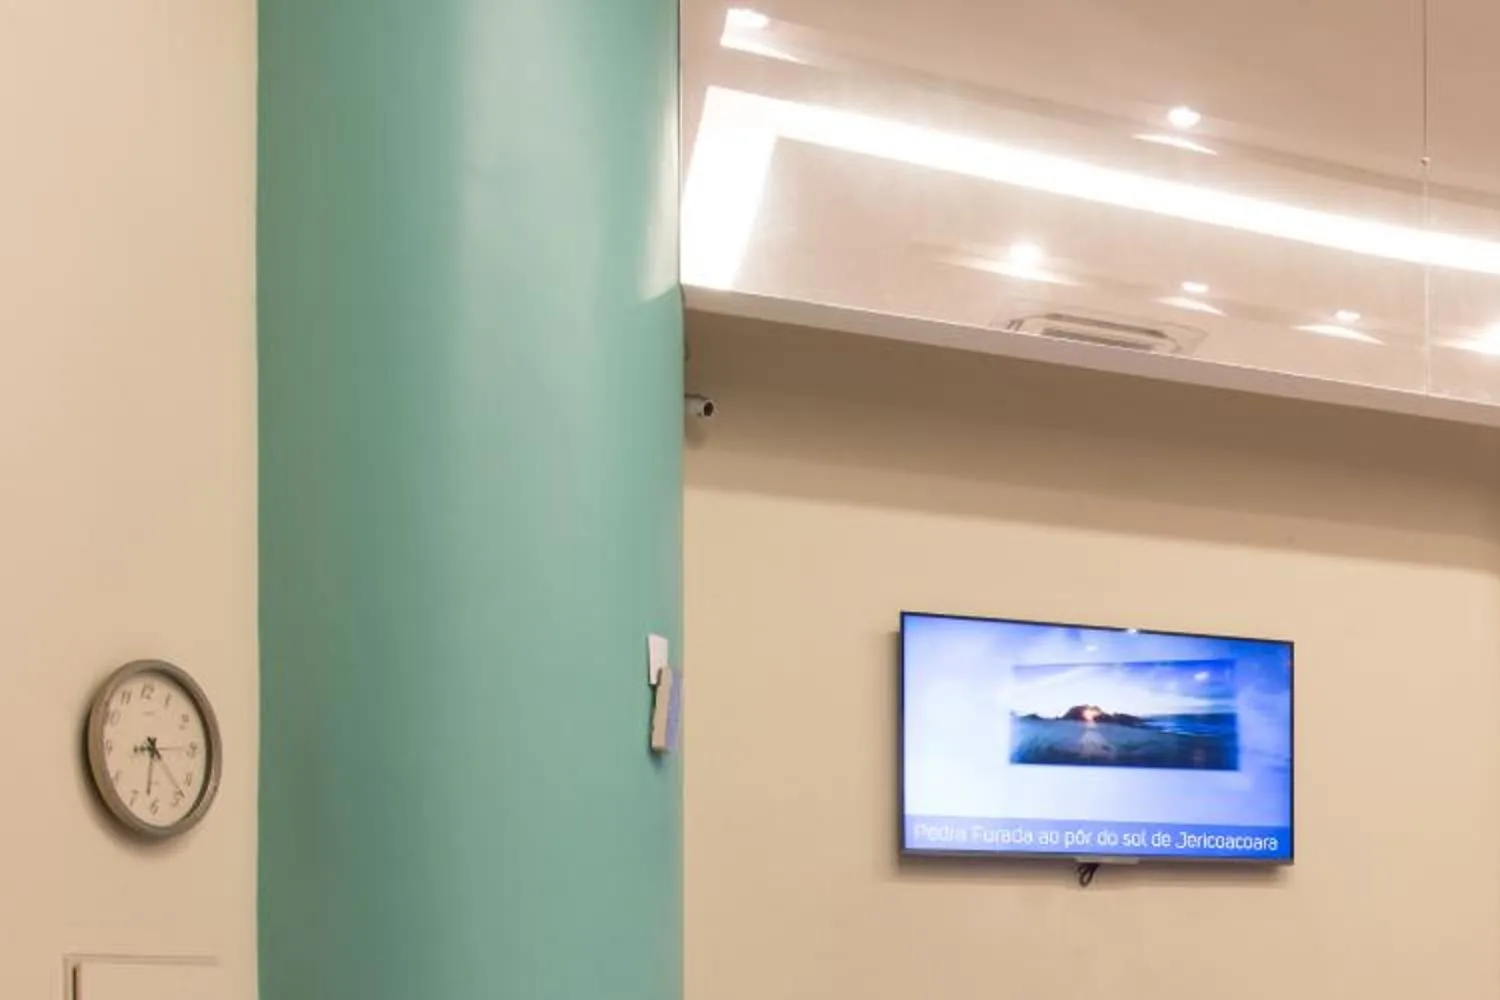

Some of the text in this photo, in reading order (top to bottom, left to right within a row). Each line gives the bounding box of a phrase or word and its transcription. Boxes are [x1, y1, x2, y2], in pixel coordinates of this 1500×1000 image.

[972, 825, 1034, 845] Furada
[1037, 831, 1060, 846] ao
[1096, 829, 1118, 846] do
[1122, 831, 1147, 847] sol
[1151, 831, 1172, 848] de
[1174, 832, 1278, 851] Jericoacoara
